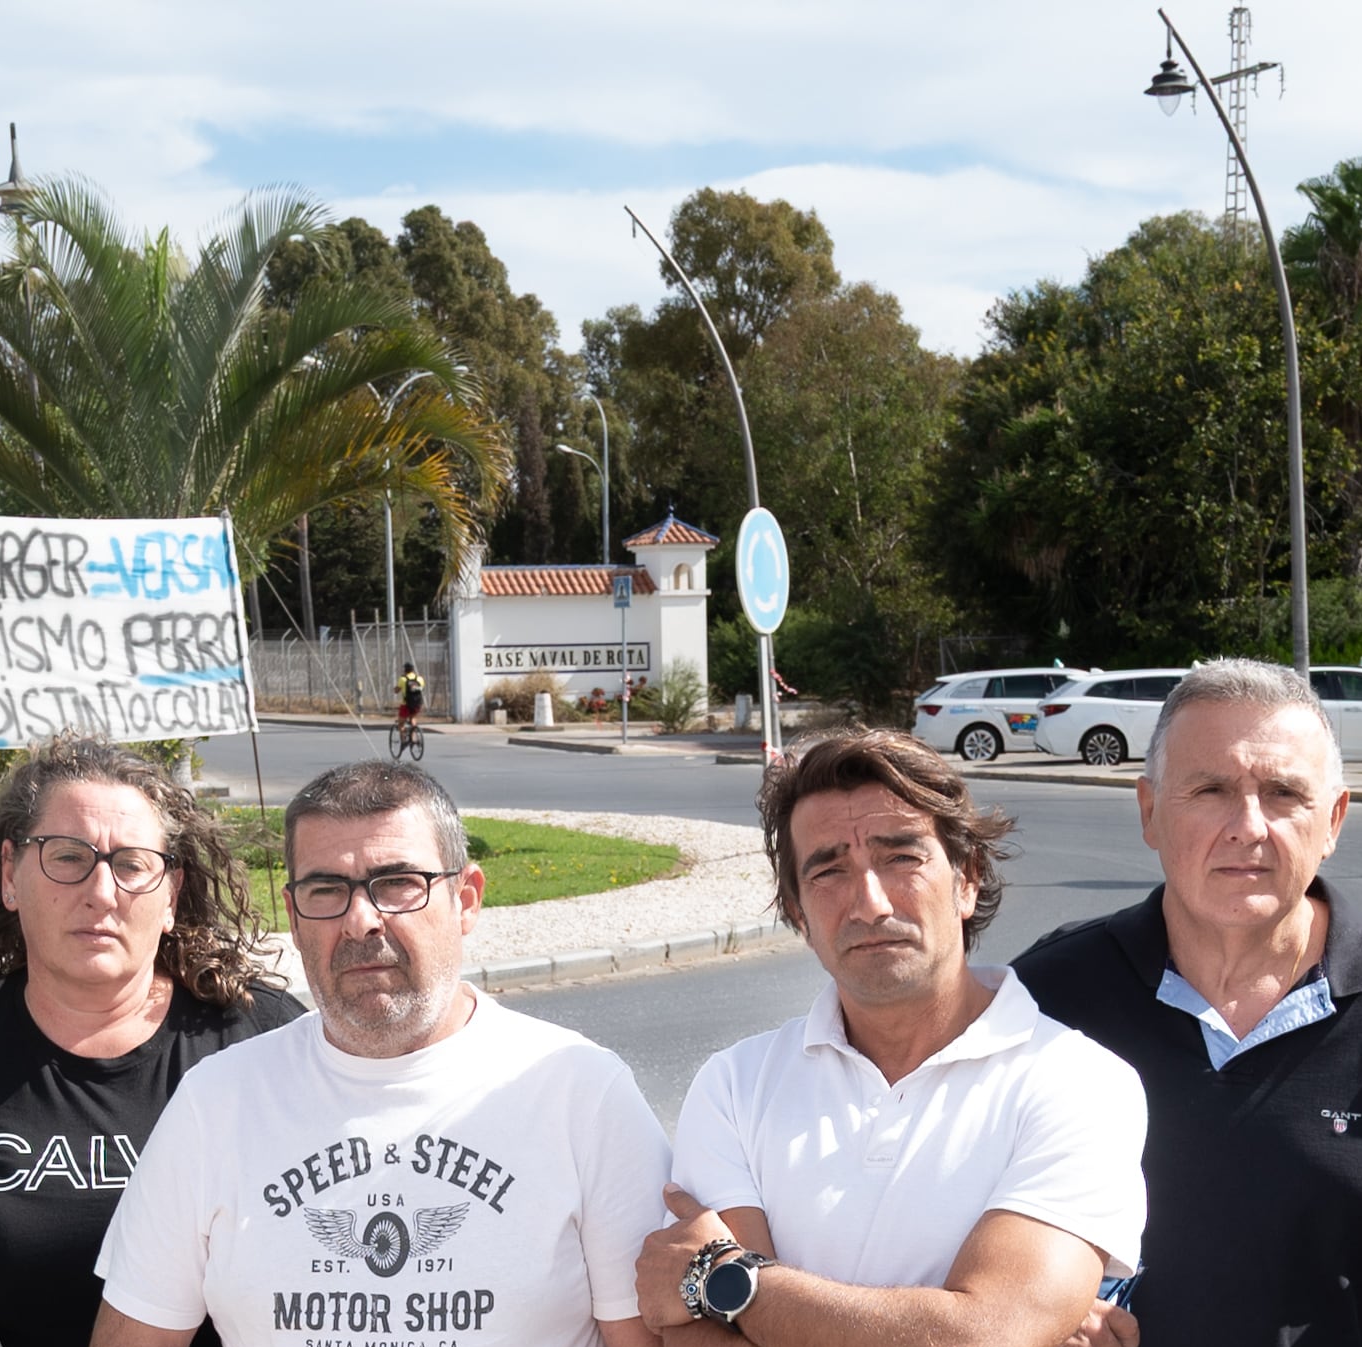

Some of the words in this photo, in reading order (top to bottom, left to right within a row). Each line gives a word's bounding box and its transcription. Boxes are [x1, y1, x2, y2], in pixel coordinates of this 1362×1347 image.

[122, 611, 243, 677] PERRO
[484, 651, 524, 668] BASE
[529, 650, 578, 667] NAVAL
[583, 650, 602, 666] DE
[1320, 1109, 1362, 1121] GANT
[263, 1136, 372, 1218] SPEED
[384, 1143, 401, 1164] &
[411, 1133, 515, 1215] STEEL
[367, 1193, 405, 1207] USA
[311, 1259, 350, 1273] EST.
[417, 1258, 453, 1273] 1971
[273, 1291, 392, 1333] MOTOR
[404, 1289, 495, 1333] SHOP
